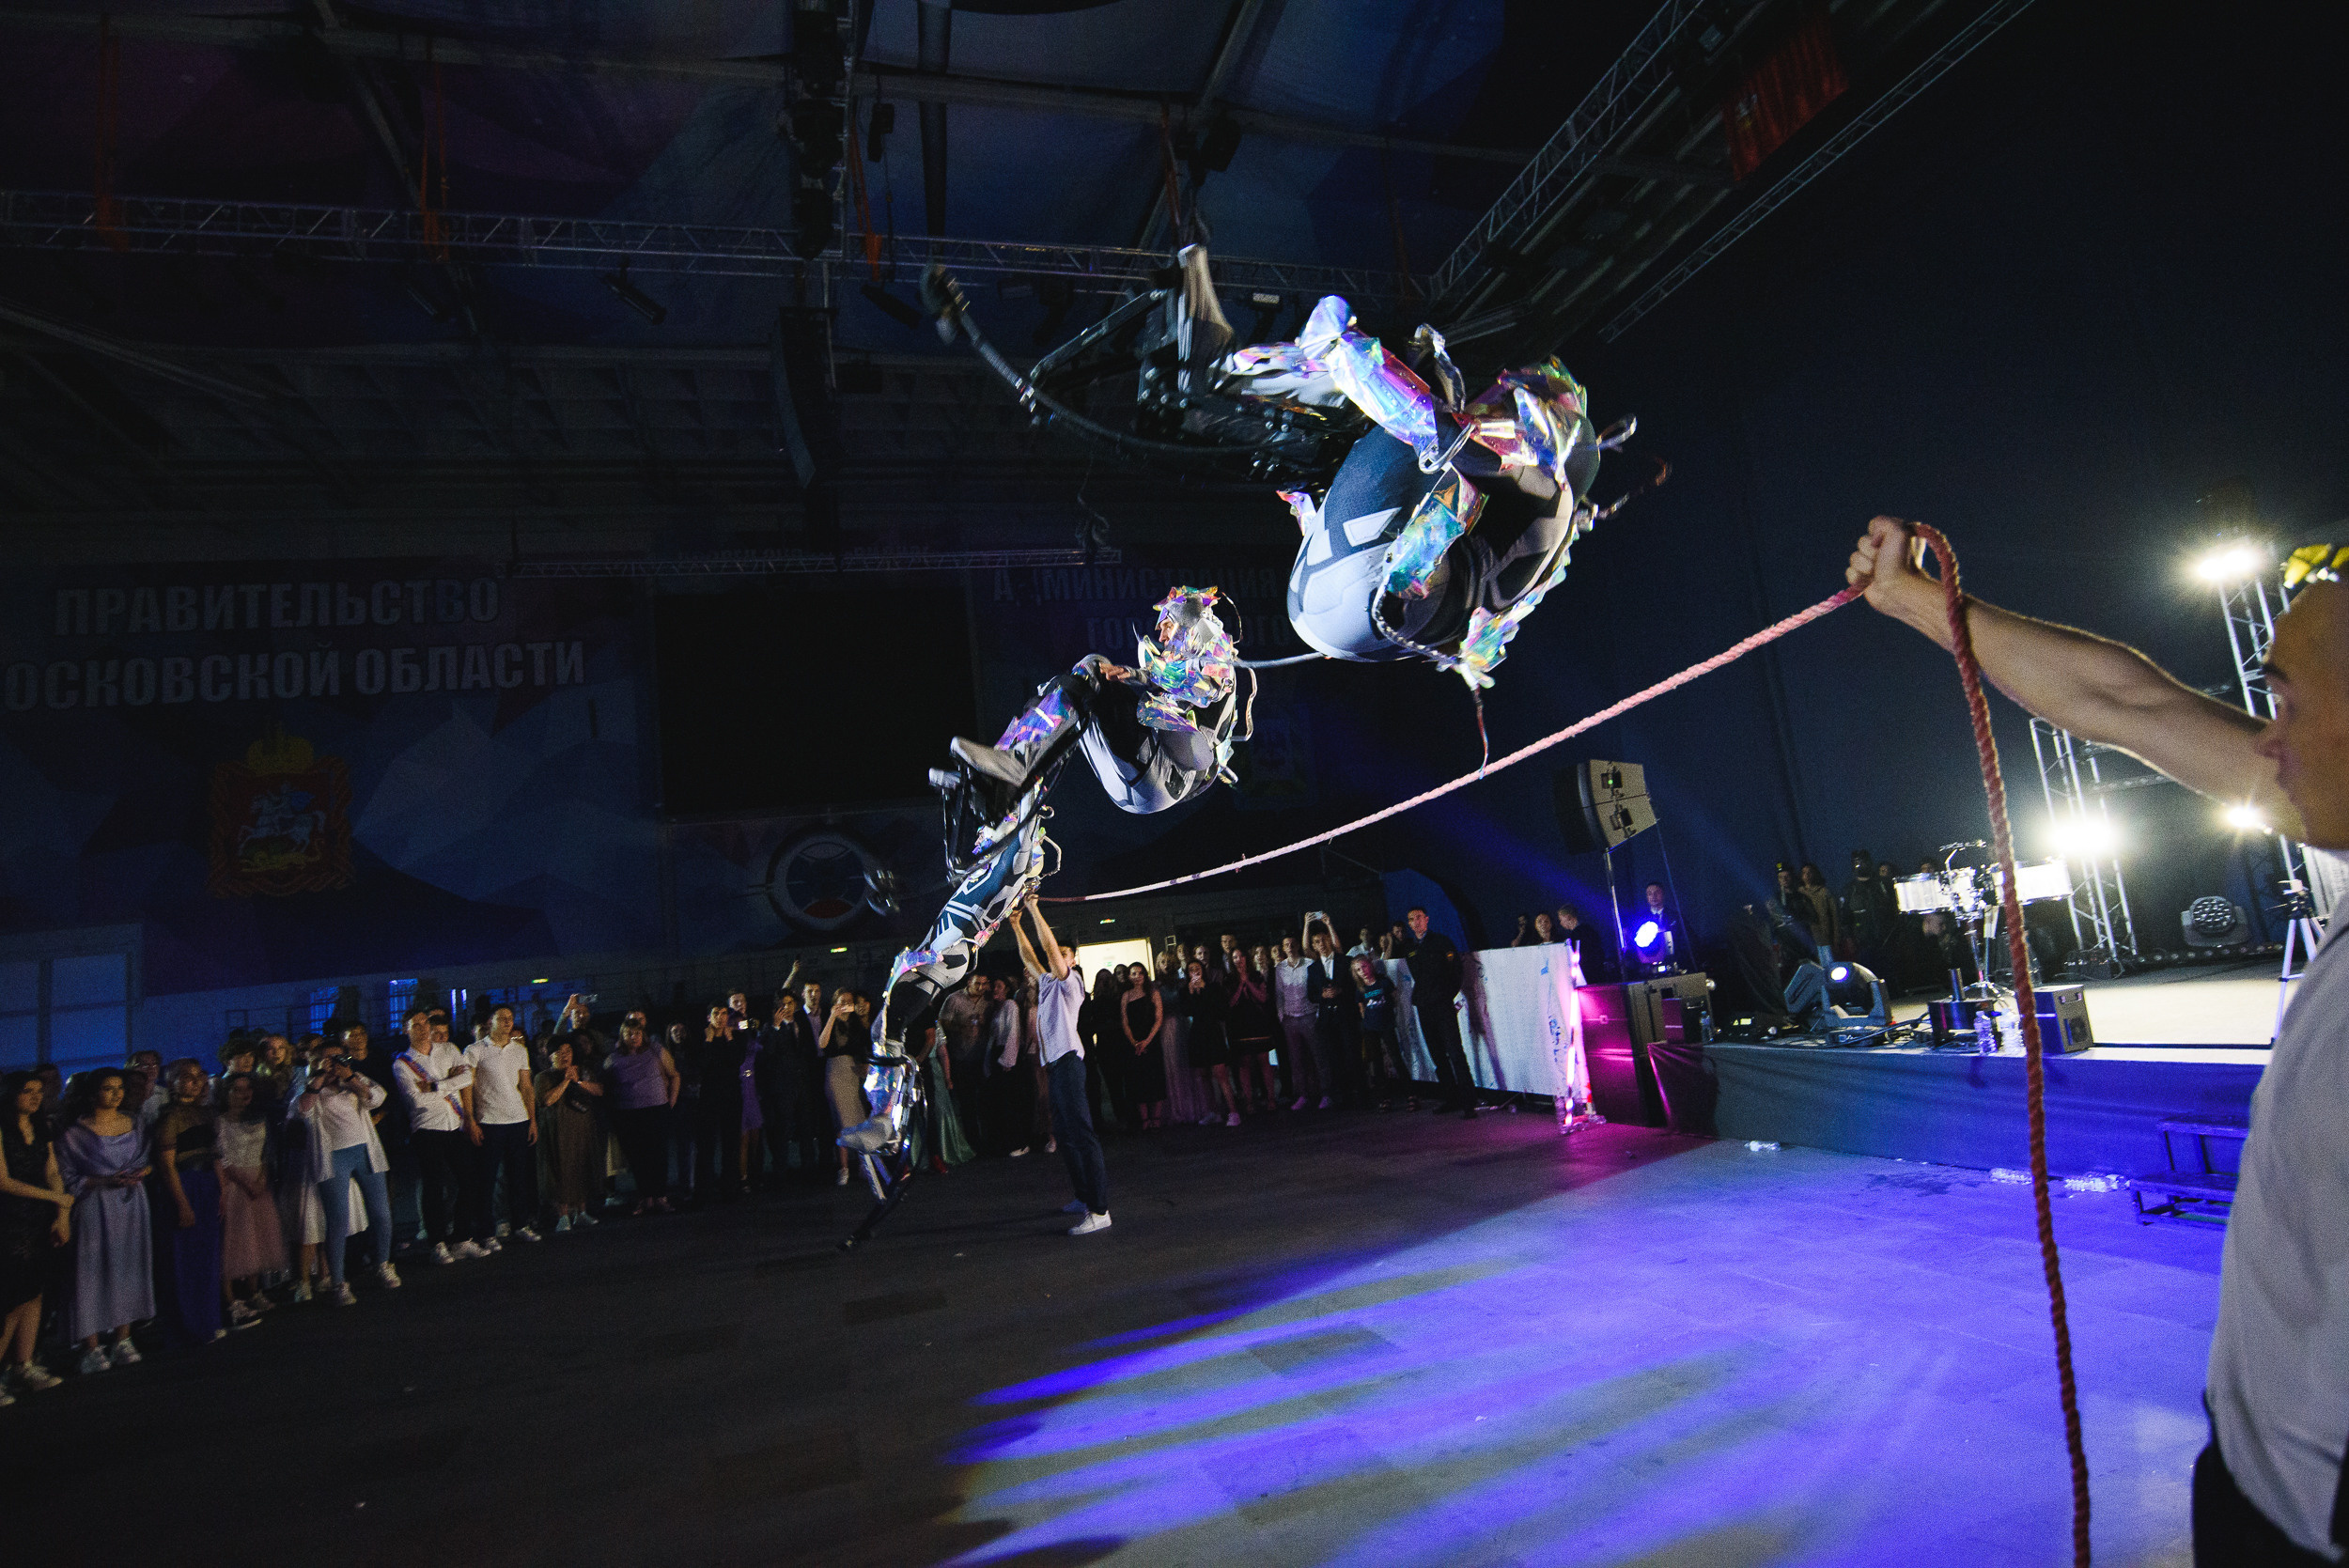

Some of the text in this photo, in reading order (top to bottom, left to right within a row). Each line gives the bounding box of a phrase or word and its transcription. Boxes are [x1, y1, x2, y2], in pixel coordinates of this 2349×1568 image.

[54, 577, 500, 636] ПРАВИТЕЛЬСТВО
[4, 641, 584, 711] ОСКОВСКОЙ ОБЛАСТИ
